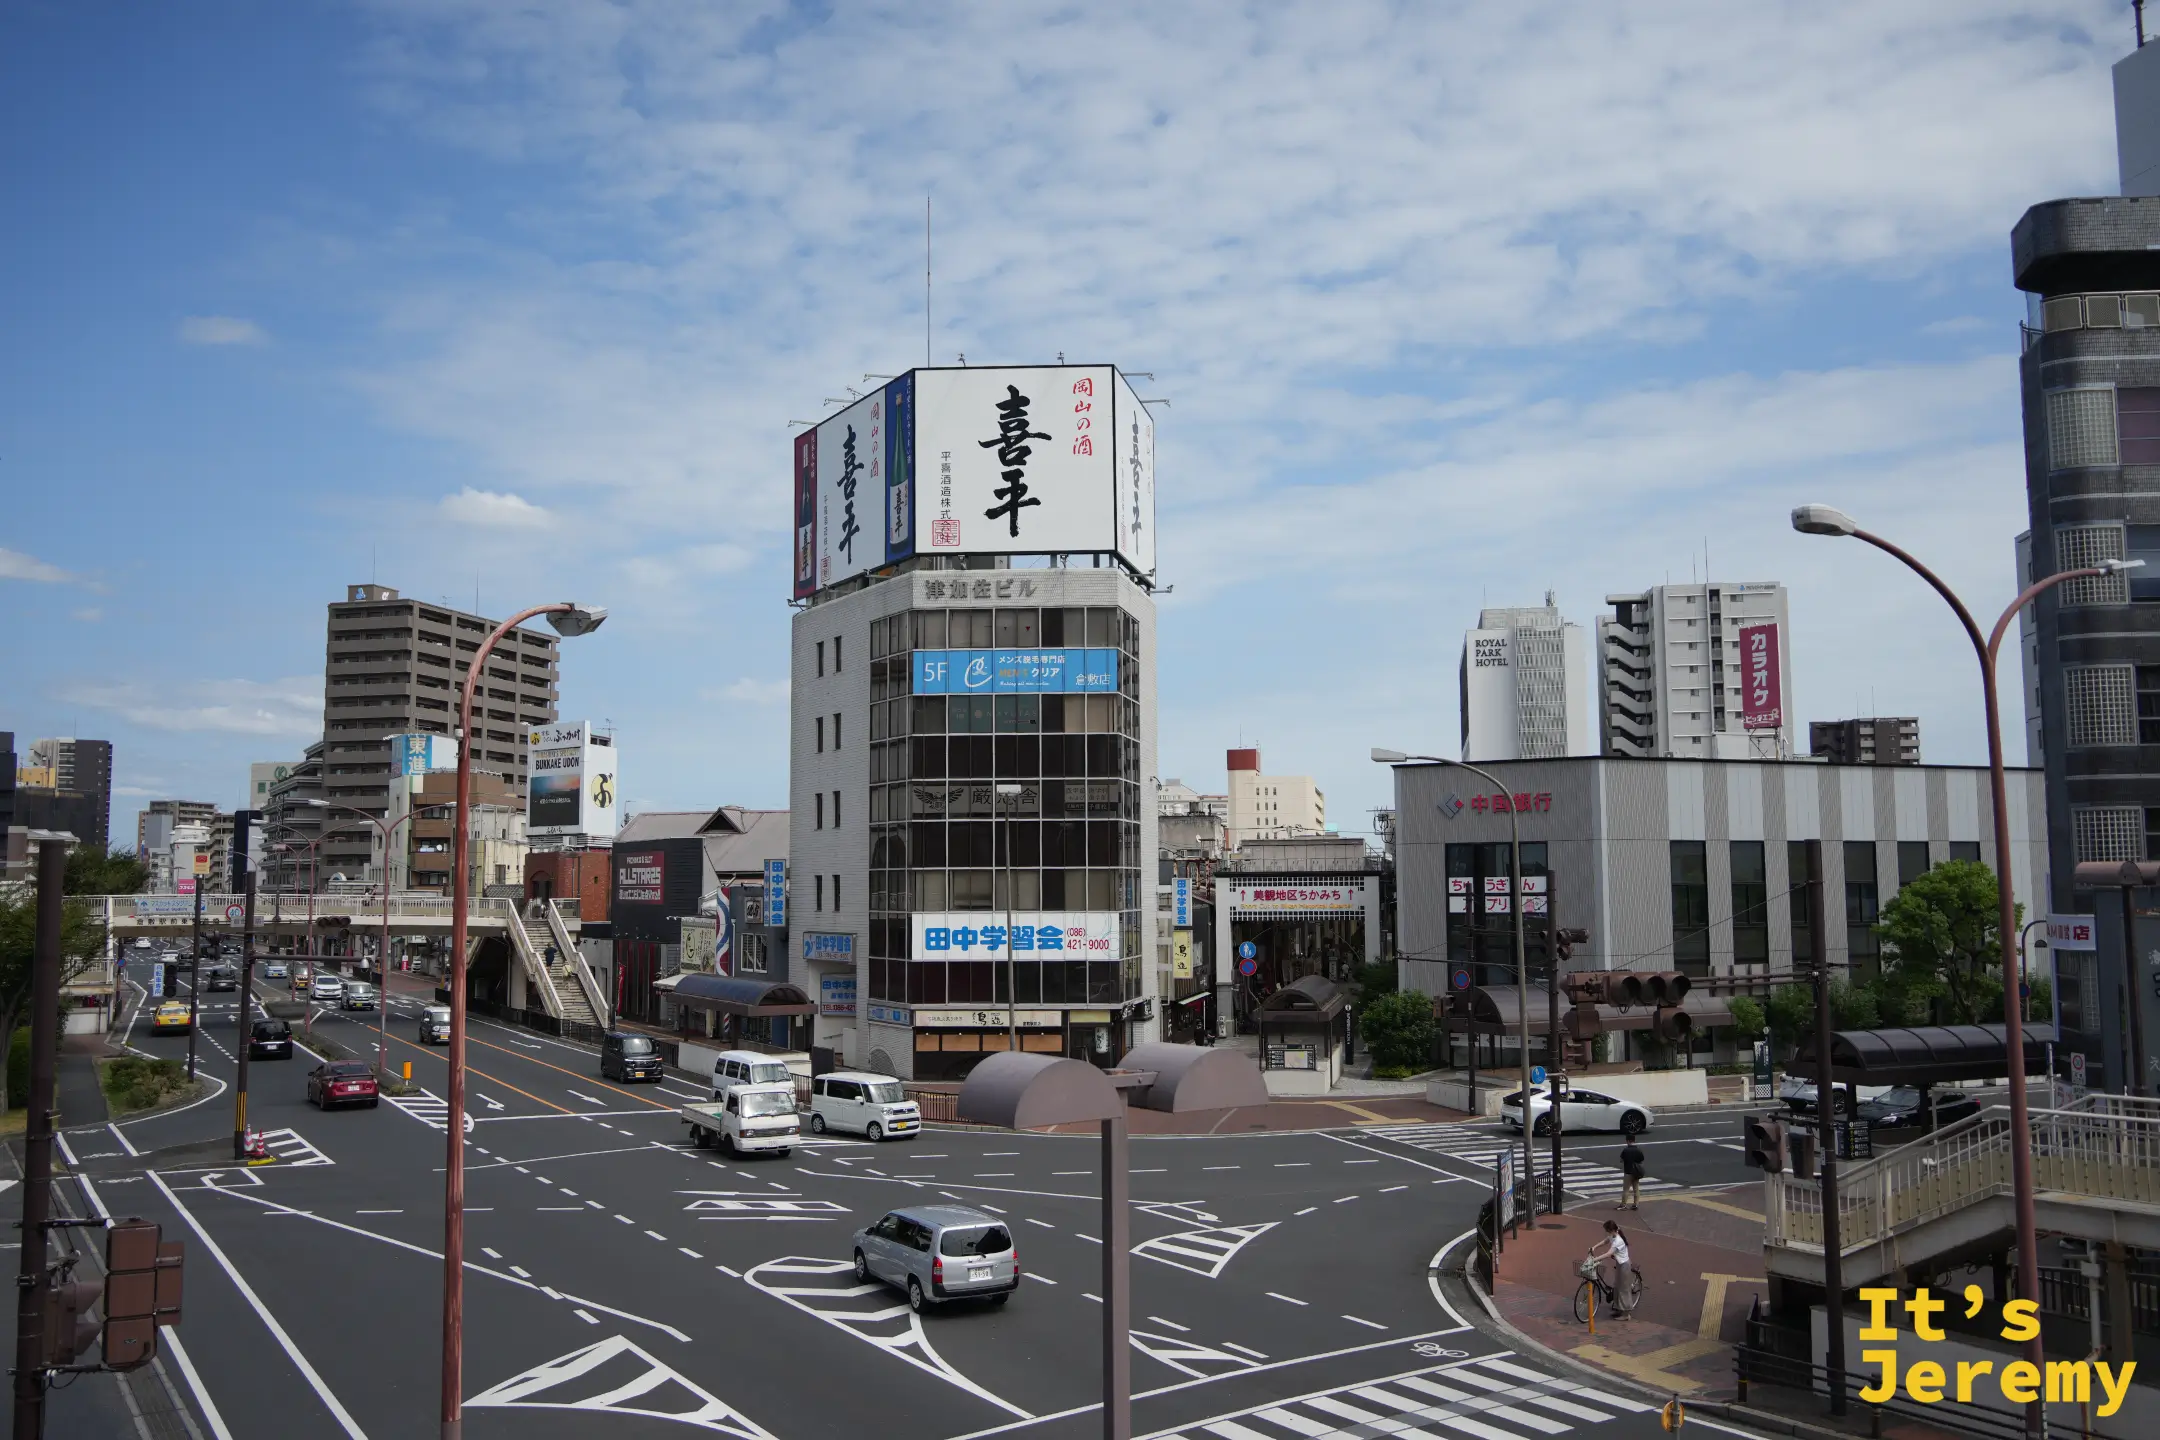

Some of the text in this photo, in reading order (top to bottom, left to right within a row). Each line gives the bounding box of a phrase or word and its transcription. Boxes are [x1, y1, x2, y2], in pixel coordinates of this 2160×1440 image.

[1072, 377, 1094, 457] 岡山の酒
[870, 402, 880, 479] 岡山の酒
[978, 384, 1052, 538] 喜平
[837, 424, 864, 565] 喜平
[925, 579, 1038, 599] 津加佐ビル
[1475, 639, 1507, 648] ROYAL
[1475, 649, 1502, 657] PARK
[998, 655, 1065, 663] メンズ脱毛専門店
[1475, 658, 1508, 667] HOTEL
[1751, 633, 1768, 706] カラオケ
[924, 662, 948, 682] 5F
[1031, 668, 1060, 677] クリア
[1075, 673, 1111, 686] 倉敷店
[409, 737, 426, 775] 東進
[535, 757, 580, 770] BUKKAKE UDON
[1471, 792, 1552, 814] 中国銀行
[771, 861, 784, 925] 田中学習会
[1176, 880, 1187, 925] 田中学習会
[1253, 889, 1341, 901] 美観地区ちかみち
[925, 925, 1110, 951] 田中学習会 (086) 421-9000
